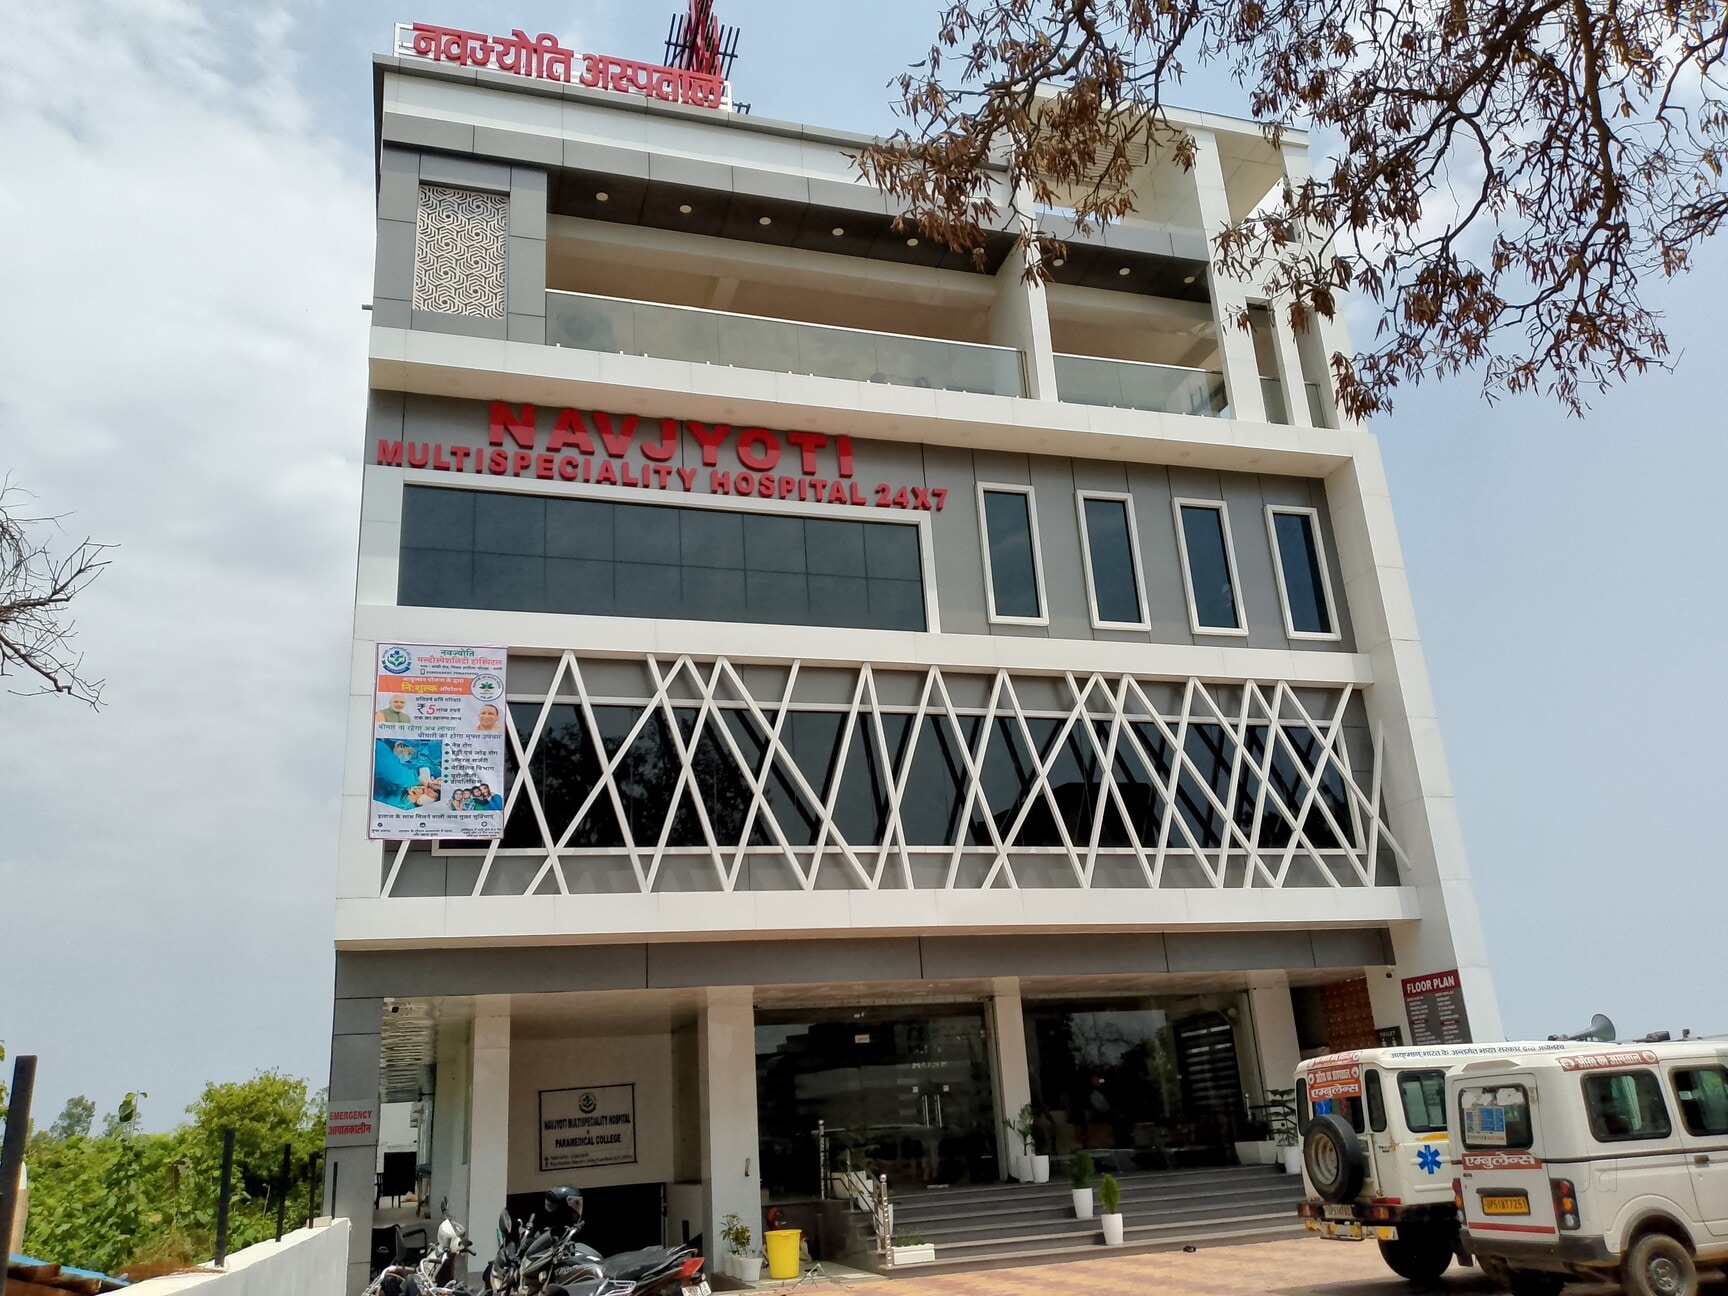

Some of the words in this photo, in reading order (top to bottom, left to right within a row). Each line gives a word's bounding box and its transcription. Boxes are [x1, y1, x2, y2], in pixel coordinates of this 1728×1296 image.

[412, 22, 574, 83] नवज्योति
[579, 53, 724, 109] अस्पताल
[488, 400, 854, 478] NAVJYOTI
[376, 439, 697, 492] MULTISPECIALITY
[710, 470, 866, 506] HOSPITAL
[874, 483, 948, 512] 24X7
[440, 648, 475, 657] नवज्योति
[1407, 980, 1433, 994] FLOOR
[1433, 975, 1455, 989] PLAN
[329, 1110, 373, 1121] EMERGENCY
[544, 1119, 567, 1131] NAVJYOTI
[567, 1116, 608, 1129] MULTISPECIALITY
[609, 1113, 631, 1125] HOSPITAL
[328, 1121, 372, 1136] आपातकालीन
[555, 1136, 595, 1148] PARAMEDICAL
[595, 1133, 621, 1144] COLLEGE
[1464, 1152, 1536, 1169] एम्बुलेन्स
